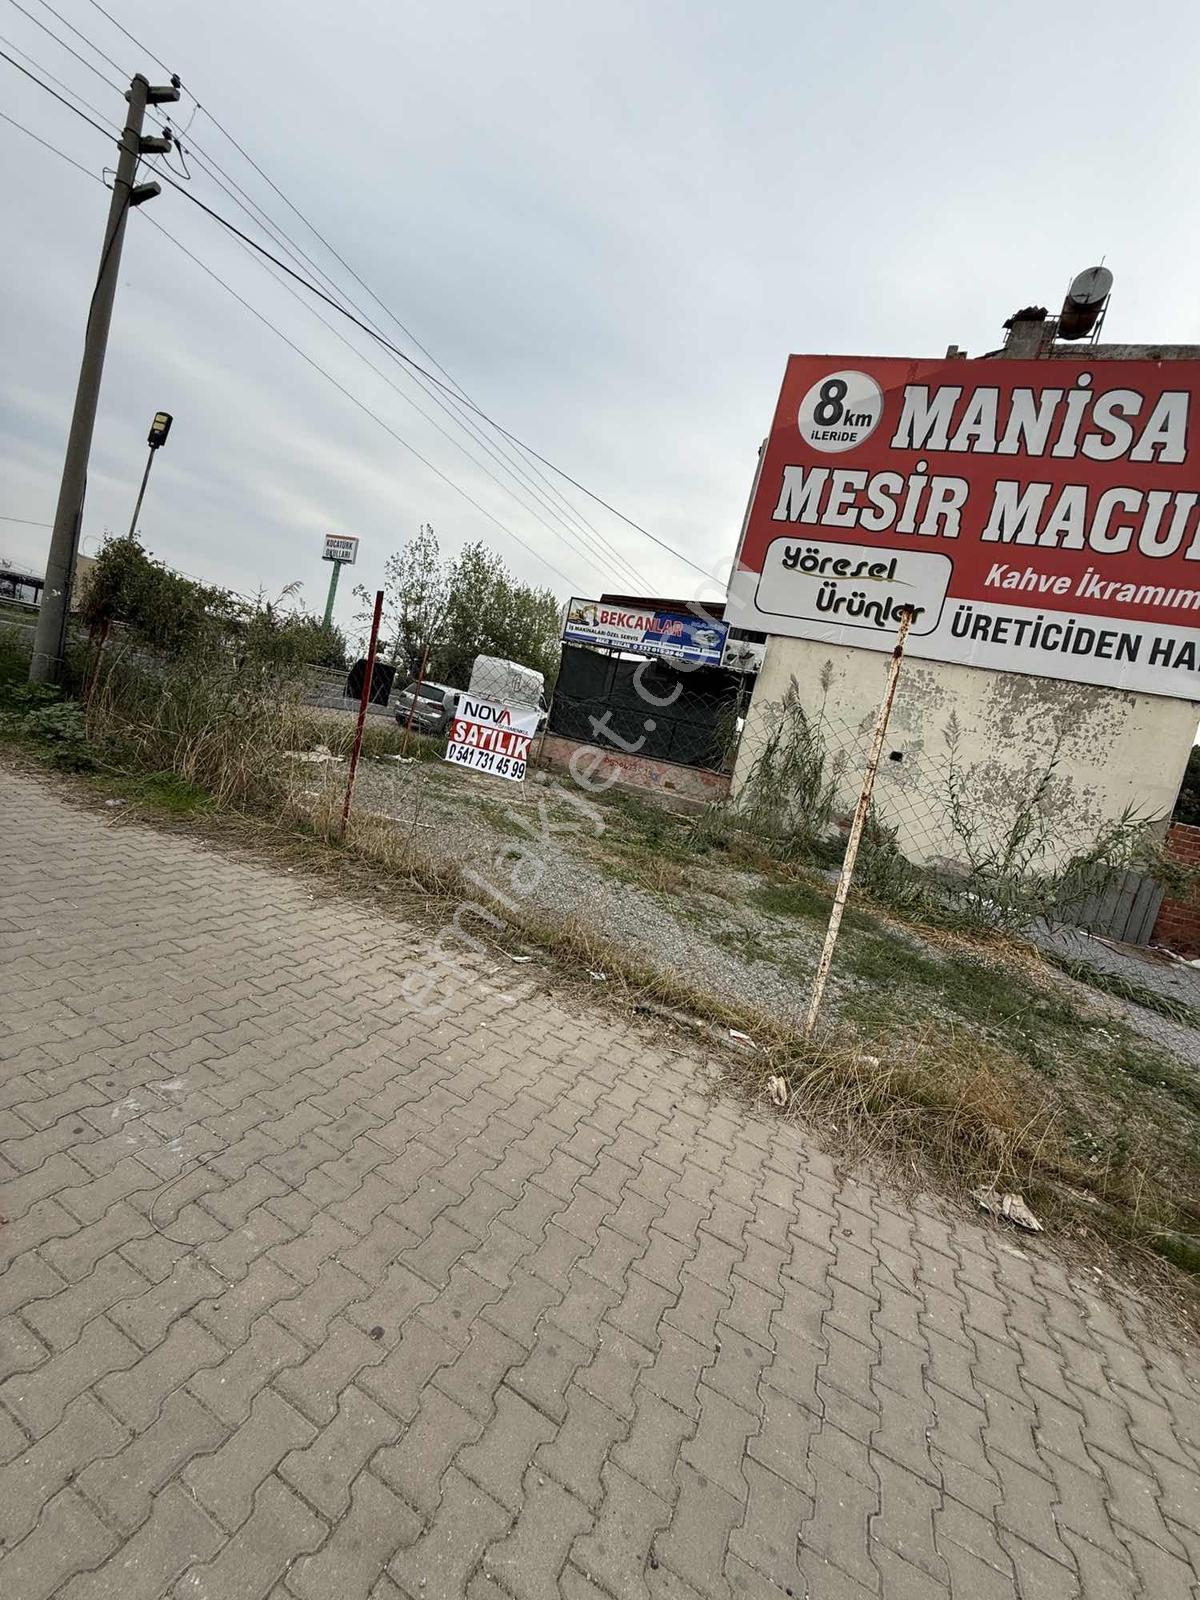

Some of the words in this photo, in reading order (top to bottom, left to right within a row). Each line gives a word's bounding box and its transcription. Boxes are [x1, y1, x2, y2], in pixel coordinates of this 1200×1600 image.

[890, 372, 1190, 464] MANİSA
[771, 460, 969, 538] MESİR
[980, 480, 1200, 562] MACU
[985, 564, 1072, 595] Kahve
[600, 610, 684, 637] BEKCANLAR
[606, 630, 619, 639] ÖZEL
[951, 605, 1142, 663] ÜRETİCİDEN
[1148, 637, 1200, 672] HA
[463, 701, 511, 726] NOVA
[453, 721, 532, 760] SATILIK
[448, 744, 456, 759] 0
[456, 745, 475, 764] 541
[475, 750, 495, 770] 731
[496, 757, 511, 775] 45
[511, 761, 525, 779] 99
